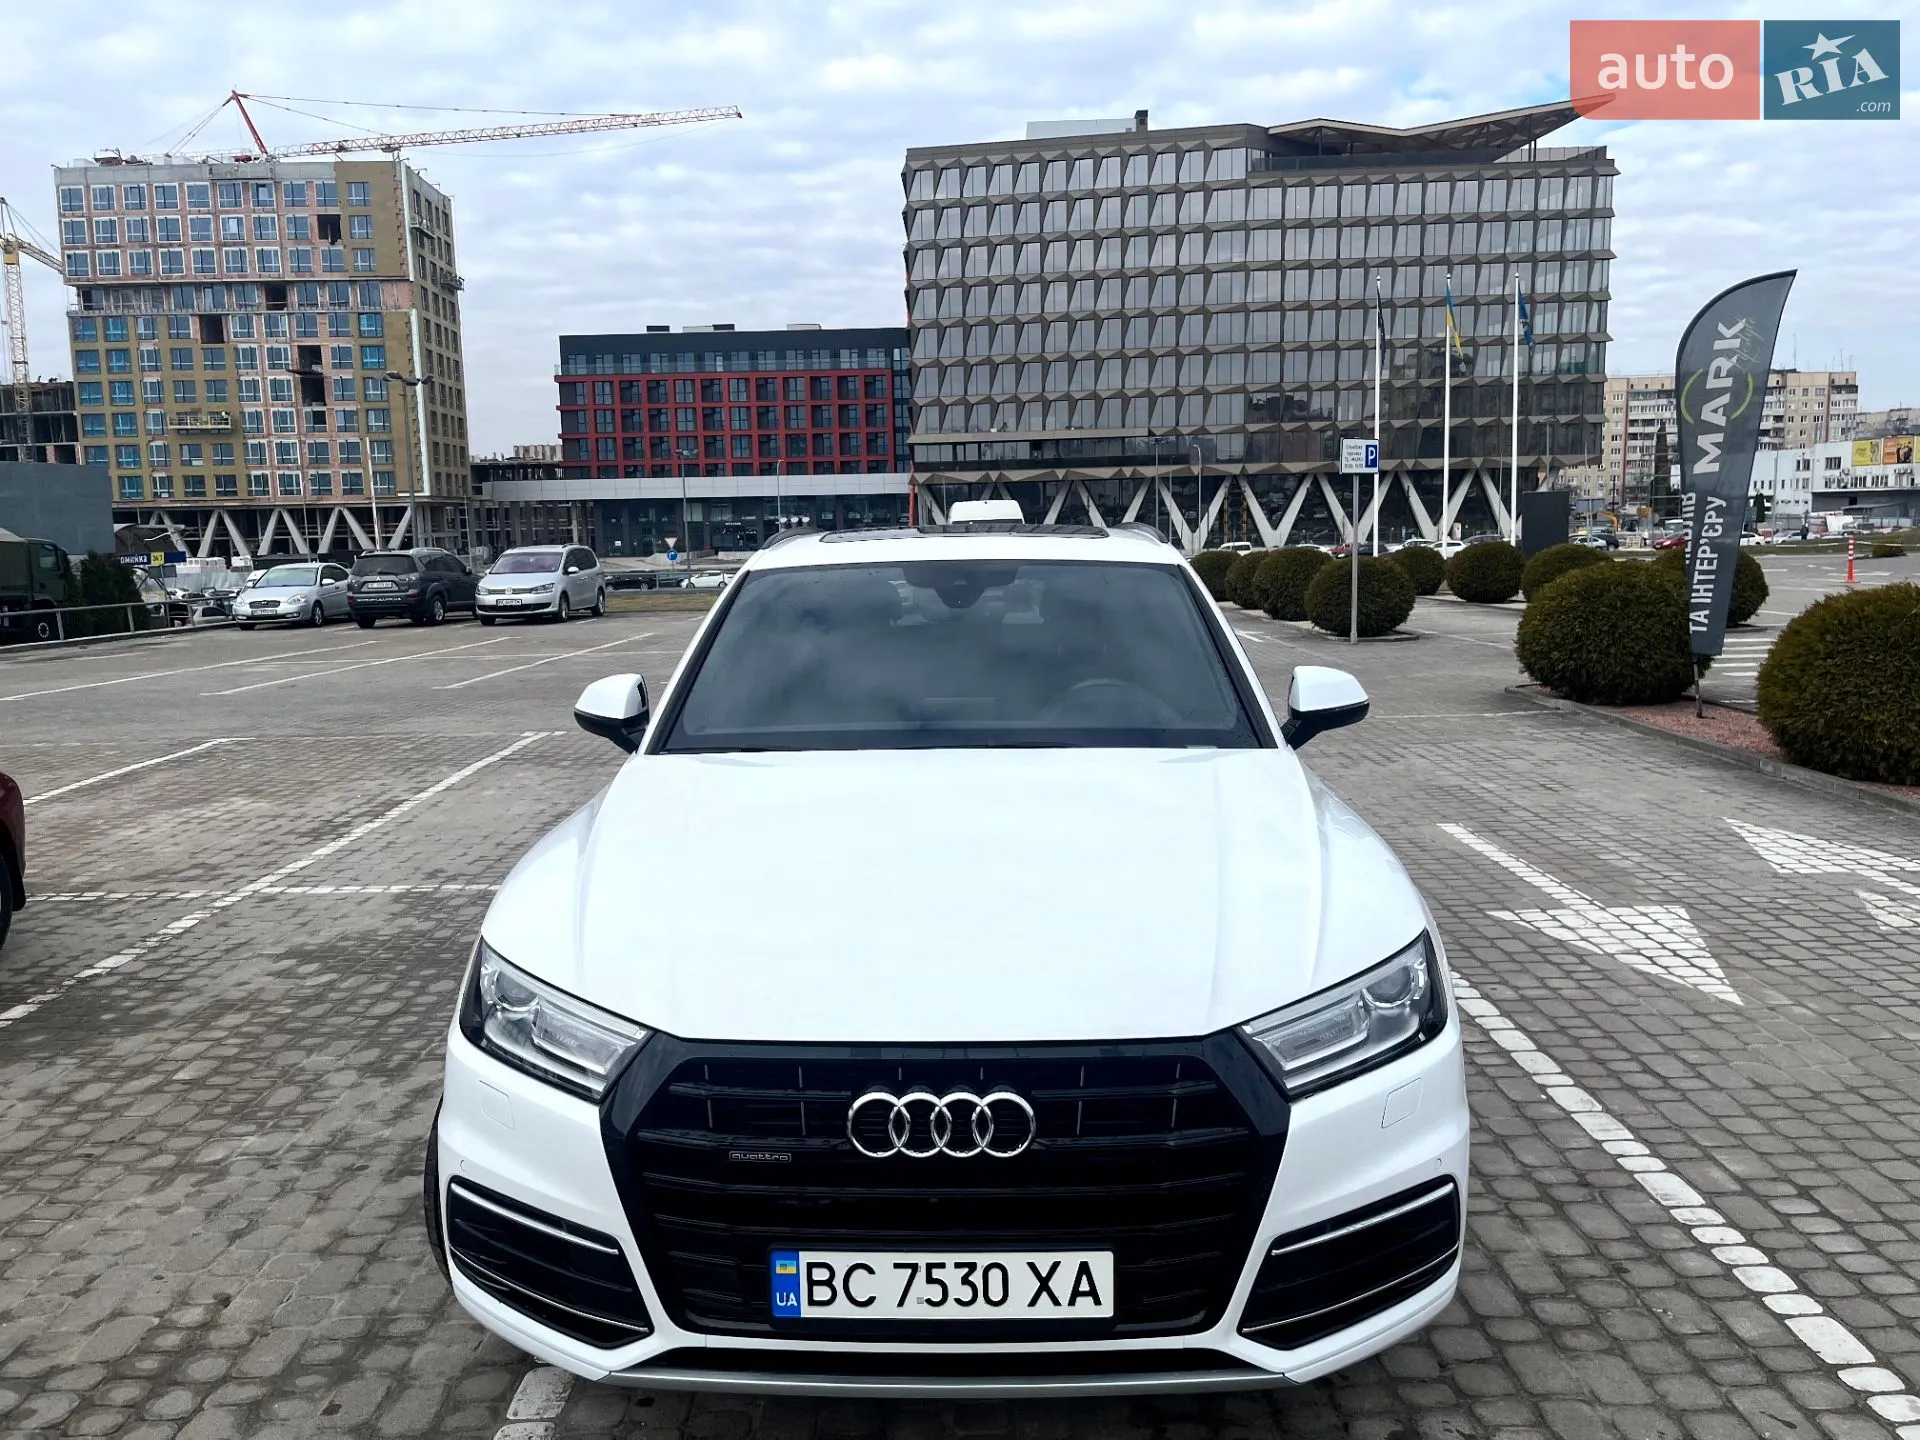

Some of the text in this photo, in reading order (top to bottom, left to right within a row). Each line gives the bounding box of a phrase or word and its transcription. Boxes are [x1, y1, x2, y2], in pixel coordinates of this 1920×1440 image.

[1692, 318, 1747, 475] MARK
[1368, 446, 1376, 466] P
[1689, 609, 1710, 634] ТА
[731, 1153, 789, 1161] quattro
[806, 1261, 1103, 1308] BC 7530 XA
[776, 1292, 798, 1307] UA
